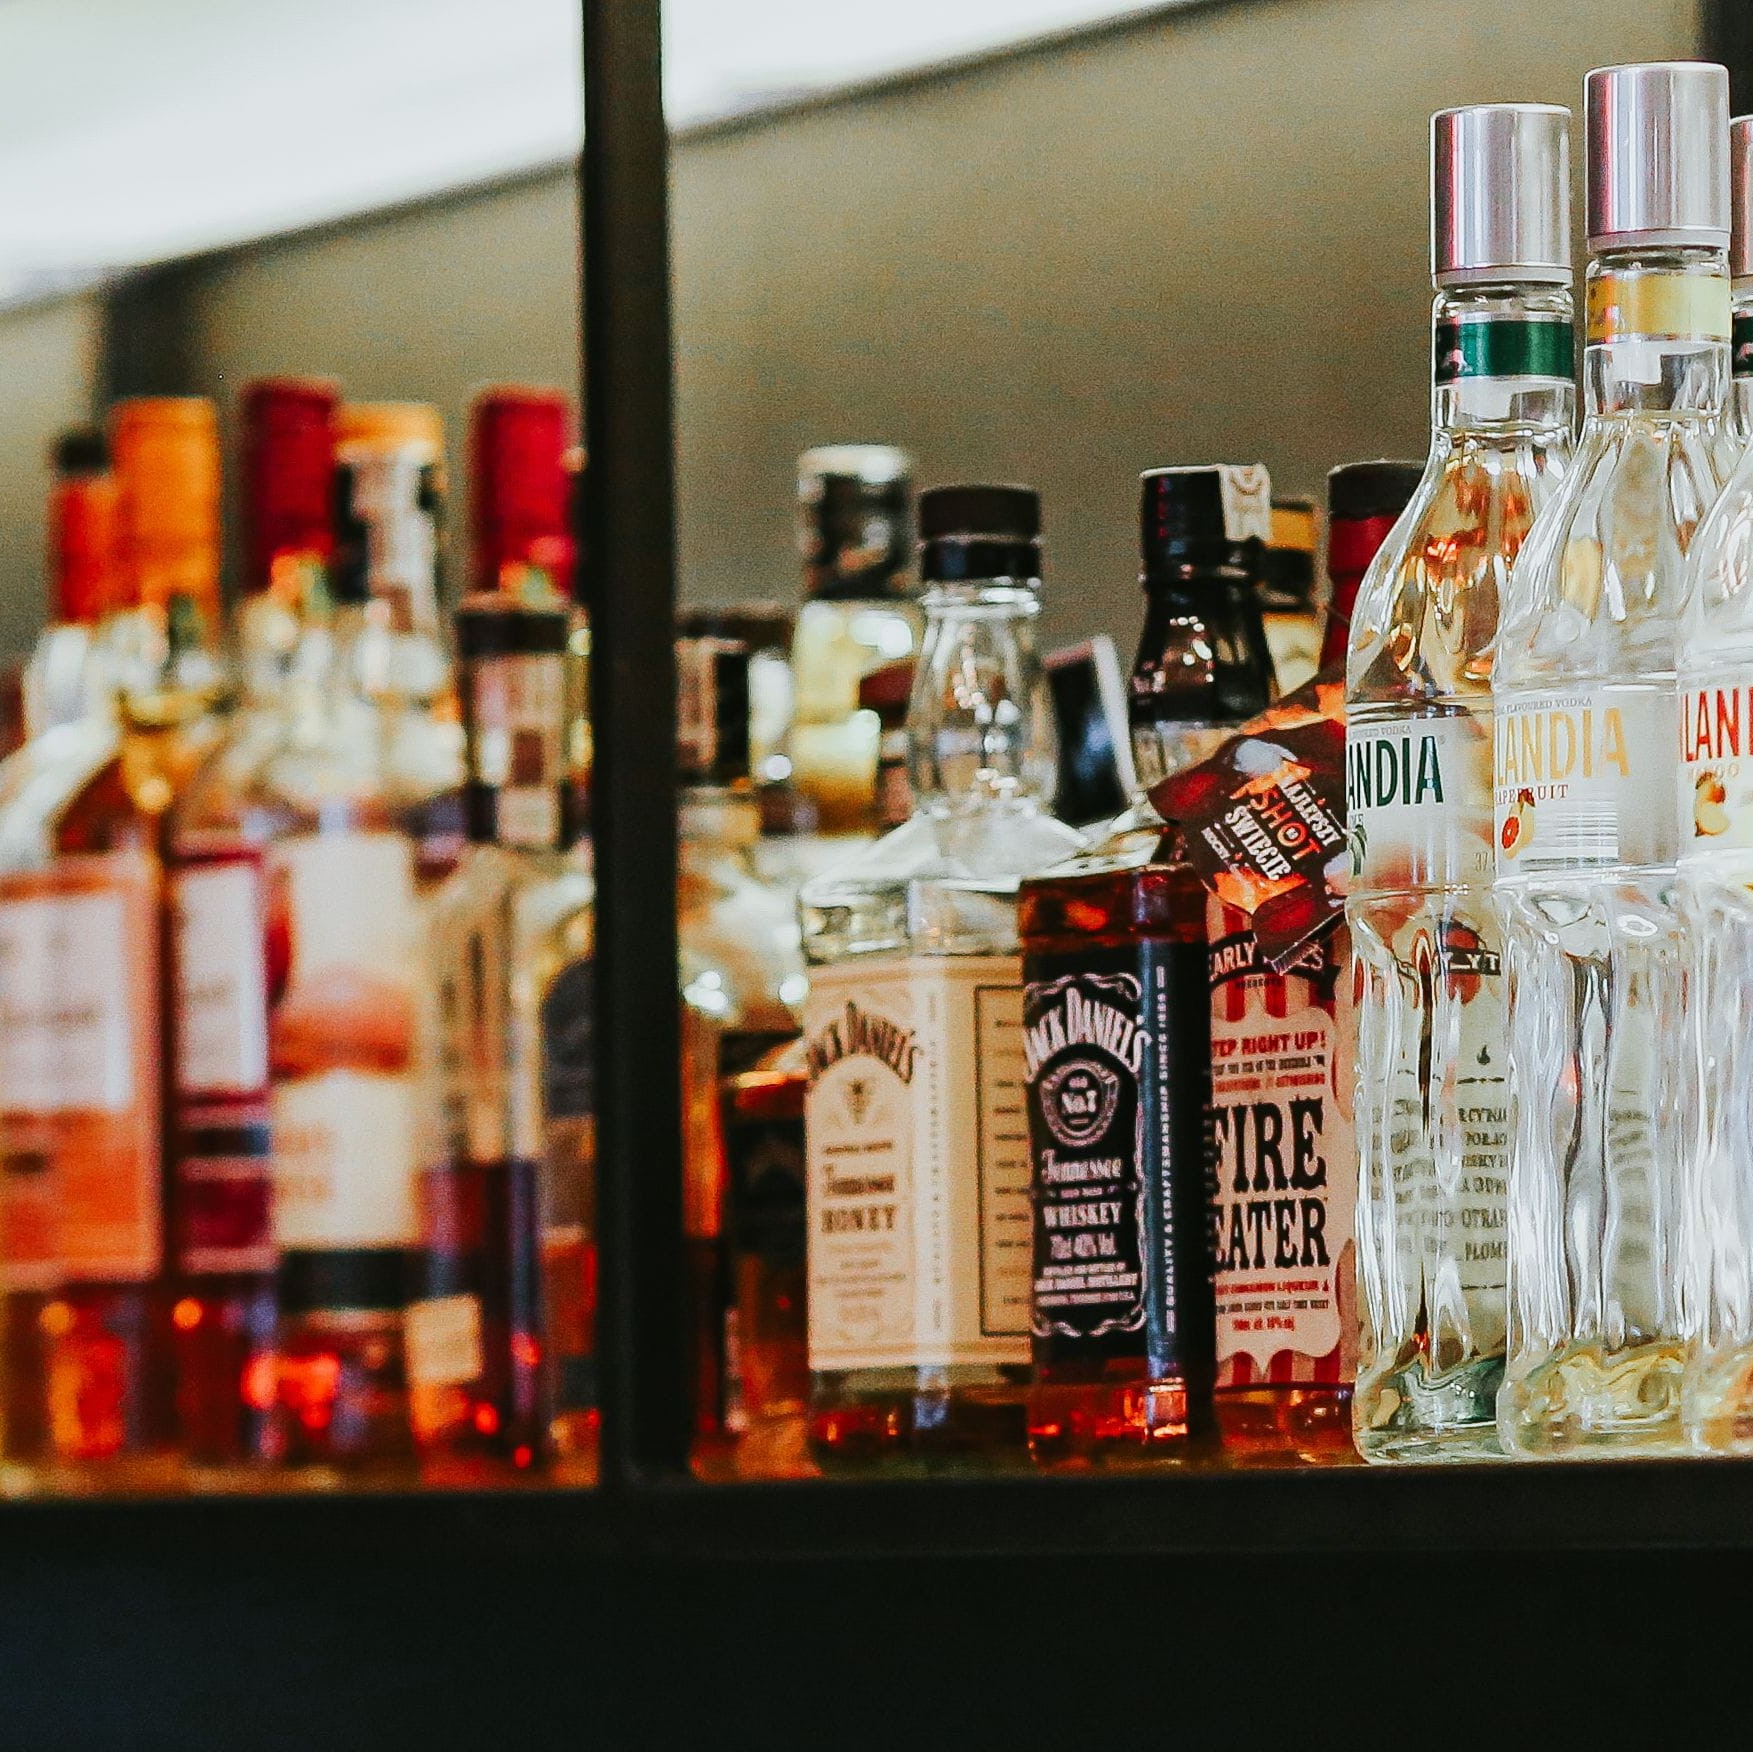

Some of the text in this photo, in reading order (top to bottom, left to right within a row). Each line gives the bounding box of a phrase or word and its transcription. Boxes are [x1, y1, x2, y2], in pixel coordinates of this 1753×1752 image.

[1497, 707, 1631, 787] LANDIA
[1250, 787, 1321, 862] SHOT
[1022, 987, 1154, 1084] JACK DANIEL'S
[1214, 1096, 1327, 1193] FIRE
[1043, 1203, 1124, 1229] WHISKEY
